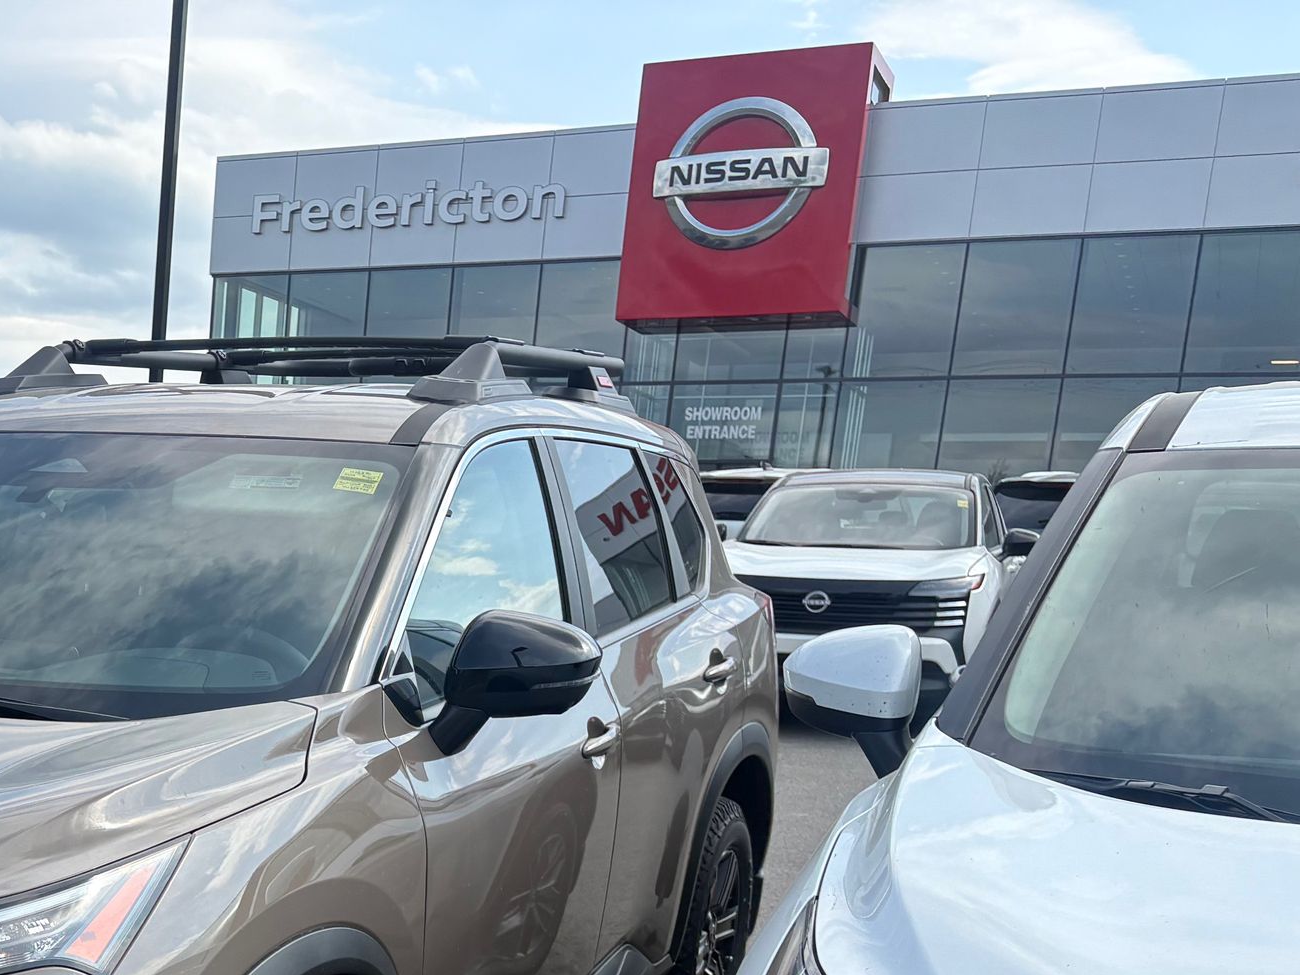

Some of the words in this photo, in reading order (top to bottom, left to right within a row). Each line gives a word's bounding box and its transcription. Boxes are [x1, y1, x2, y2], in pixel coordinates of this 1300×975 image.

[668, 155, 810, 188] NISSAN
[251, 179, 567, 235] Fredericton
[684, 406, 762, 421] SHOWROOM
[685, 425, 756, 439] ENTRANCE
